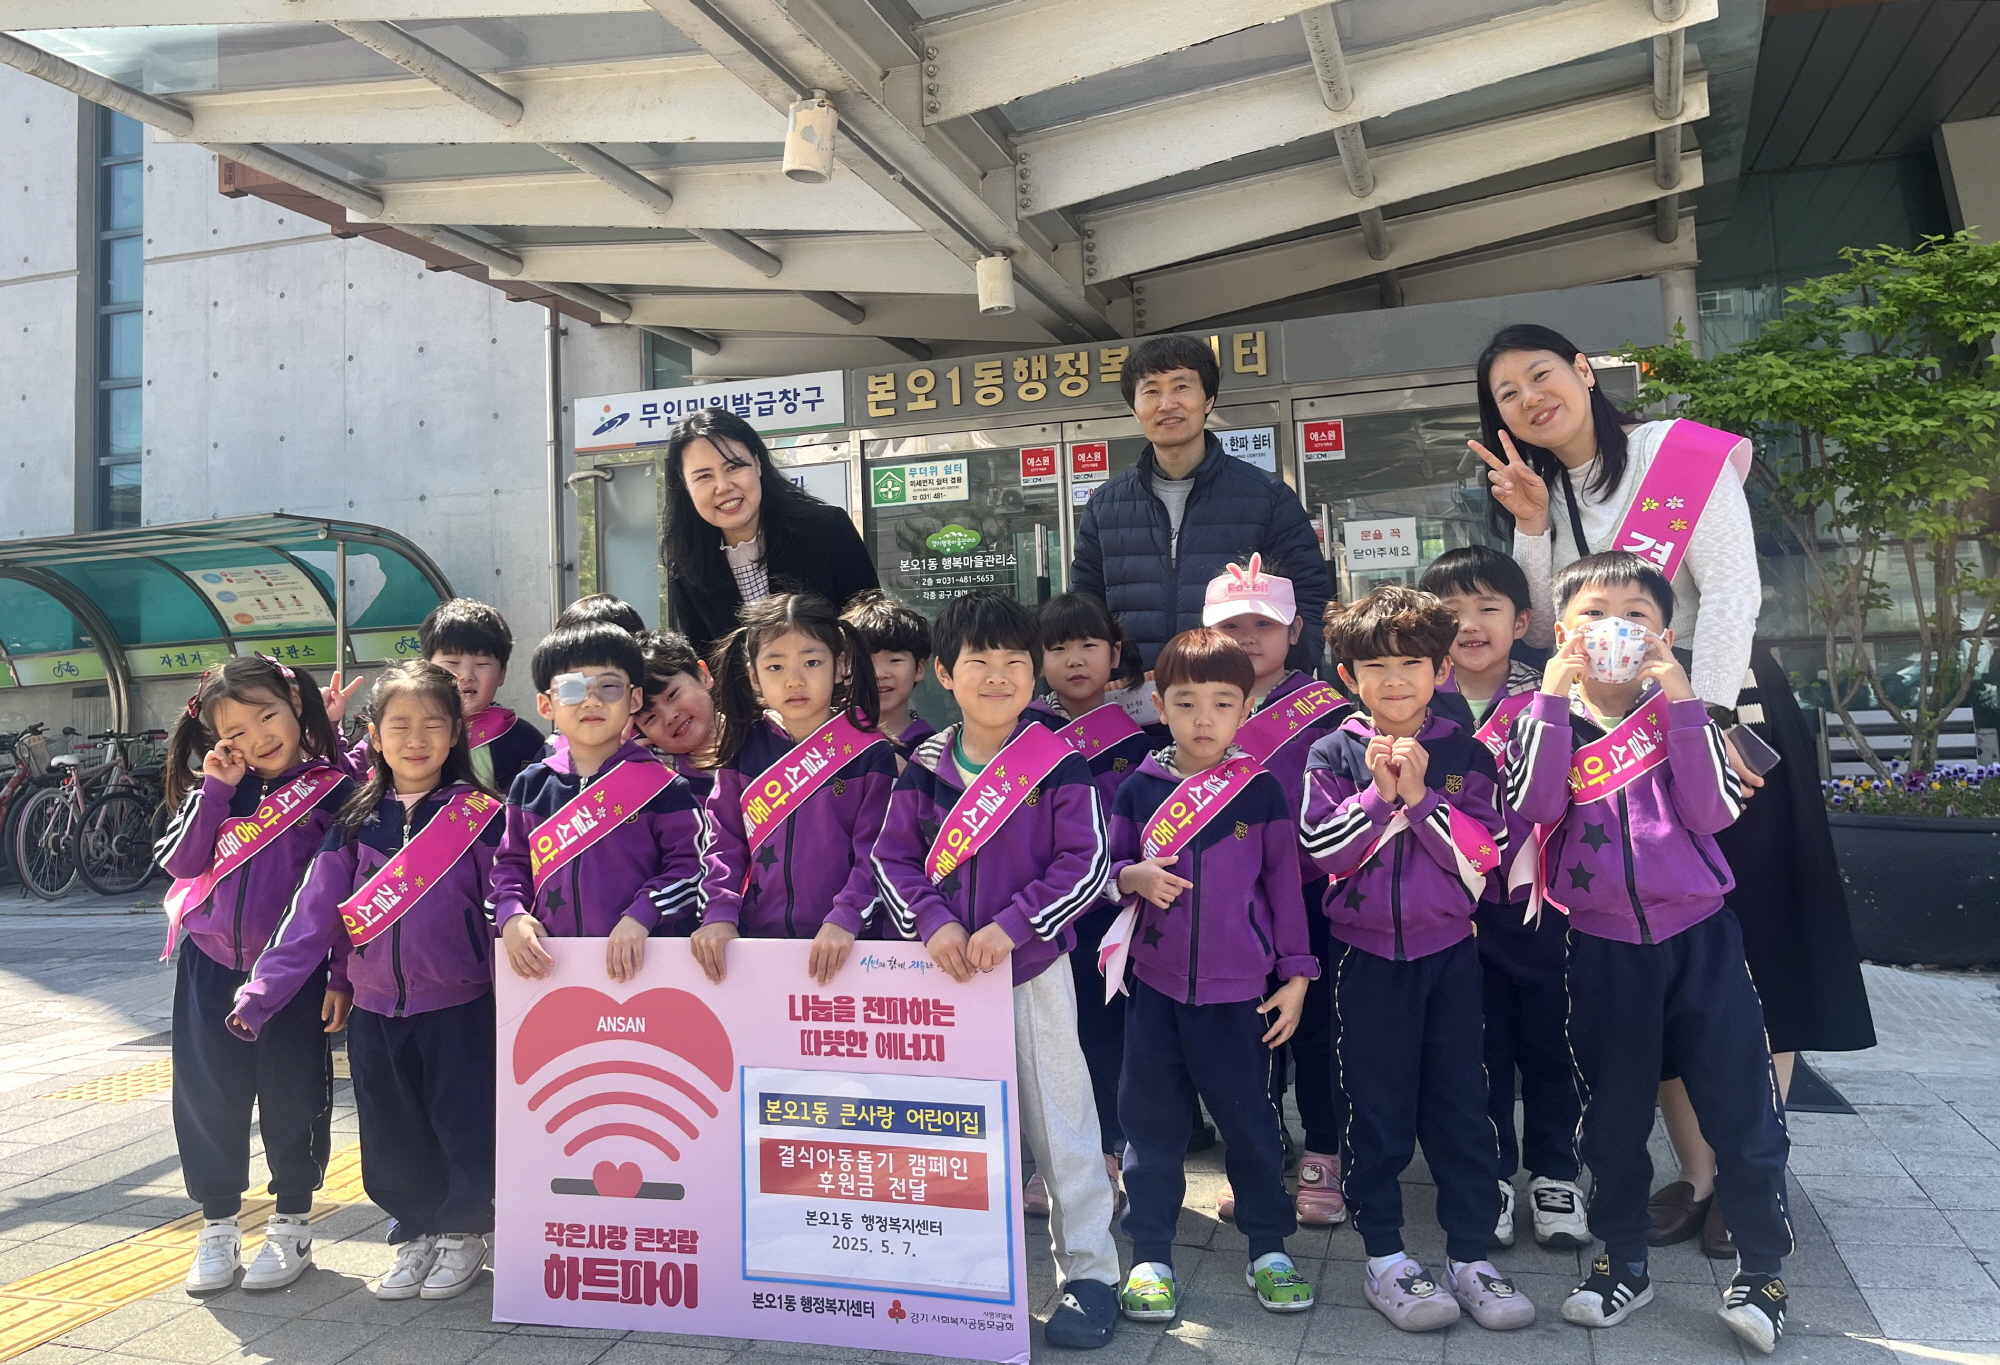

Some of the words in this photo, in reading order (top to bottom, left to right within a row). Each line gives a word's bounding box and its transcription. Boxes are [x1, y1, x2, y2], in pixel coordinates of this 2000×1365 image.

[867, 331, 1268, 417] 본오1동행정복터
[1252, 433, 1271, 450] 쉼터
[1309, 430, 1336, 442] 에스원
[1026, 456, 1050, 467] 에스원
[1077, 452, 1101, 463] 에스원
[908, 466, 938, 478] 무더위
[943, 463, 963, 475] 쉼터
[910, 478, 935, 487] 미세먼지
[936, 477, 949, 486] 쉼터
[950, 476, 963, 484] 겸용
[1360, 529, 1383, 541] 문을
[1389, 528, 1401, 538] 꼭
[1353, 546, 1411, 559] 닫아주세요
[900, 559, 938, 572] 본오1동
[941, 554, 1017, 569] 행복마을관리소
[922, 577, 934, 586] 2층
[941, 574, 995, 585] 031-481-5653
[271, 645, 316, 659] 보관소
[788, 994, 856, 1023] 나눔을
[863, 996, 956, 1027] 전파하는
[597, 1016, 646, 1033] ANSAN
[800, 1029, 868, 1058] 따뜻한
[875, 1032, 945, 1062] 에너지
[764, 1100, 830, 1125] 본오1동
[839, 1103, 895, 1130] 큰사랑
[906, 1109, 979, 1135] 어린이집
[778, 1145, 894, 1174] 결식아동돕기
[908, 1153, 969, 1180] 캠페인
[817, 1171, 875, 1198] 후원금
[888, 1177, 928, 1201] 전달
[805, 1210, 854, 1230] 본오1동
[861, 1213, 943, 1237] 행정복지센터
[545, 1222, 628, 1251] 작은사랑
[634, 1227, 699, 1254] 큰보람
[832, 1235, 873, 1253] 2025.
[881, 1240, 894, 1255] 5.
[902, 1241, 916, 1257] 7.
[543, 1253, 699, 1309] 하트파이
[752, 1292, 797, 1312] 본오1동
[800, 1295, 875, 1319] 행정복지센터
[910, 1312, 929, 1324] 경기
[931, 1314, 1014, 1331] 사회복지공동모금회
